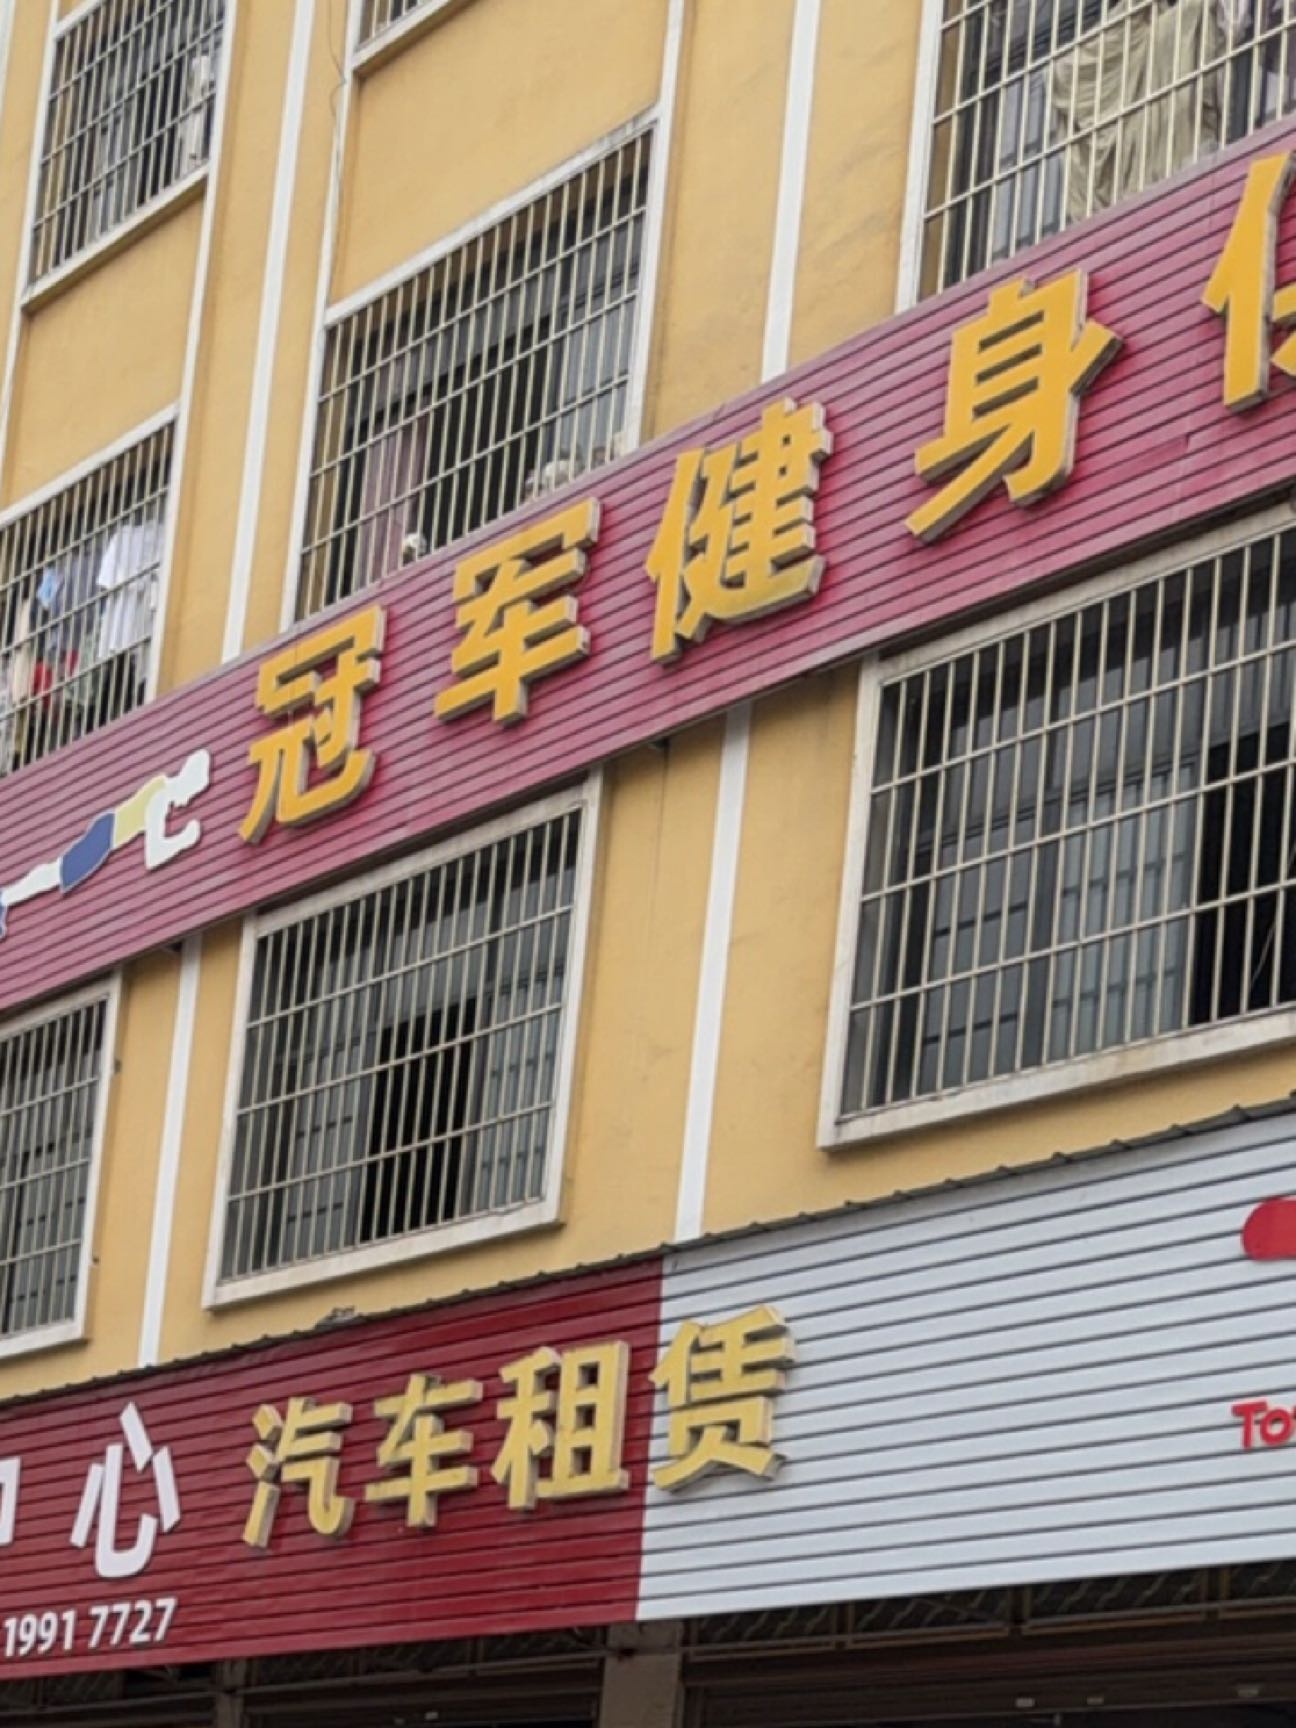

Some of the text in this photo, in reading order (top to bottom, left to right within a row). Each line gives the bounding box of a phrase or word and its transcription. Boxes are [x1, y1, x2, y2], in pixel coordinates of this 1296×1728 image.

[242, 1303, 796, 1549] 汽车租赁
[1231, 1400, 1296, 1450] To
[3, 1608, 77, 1658] 1991
[87, 1596, 178, 1650] 7727
